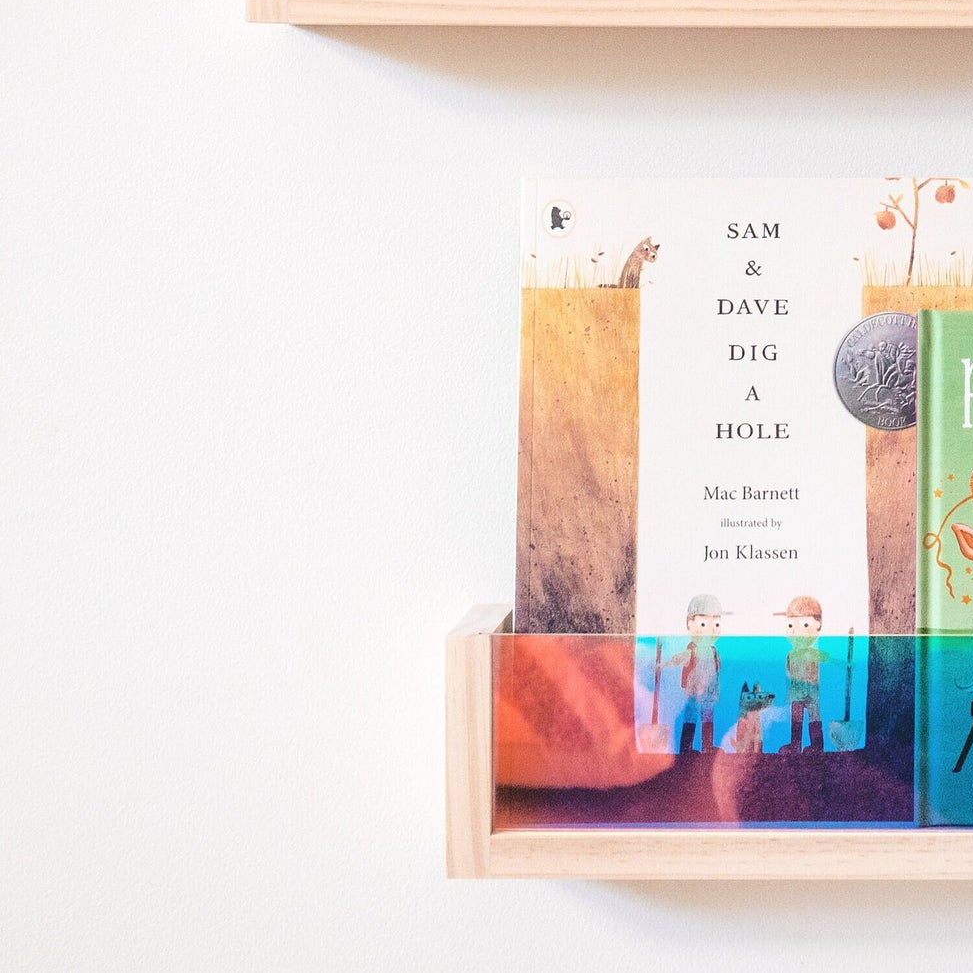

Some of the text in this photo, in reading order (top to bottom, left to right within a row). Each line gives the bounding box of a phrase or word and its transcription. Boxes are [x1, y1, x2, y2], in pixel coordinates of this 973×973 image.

[727, 222, 781, 240] SAM
[745, 259, 762, 277] &
[717, 298, 789, 316] DAVE
[846, 313, 908, 348] CALDECOTT
[728, 344, 778, 362] DIG
[744, 385, 761, 402] A
[877, 414, 908, 428] BOOK
[715, 422, 790, 440] HOLE
[703, 485, 800, 501] Mac Barnett
[719, 518, 783, 531] illustrated by
[703, 545, 798, 563] Jon Klassen
